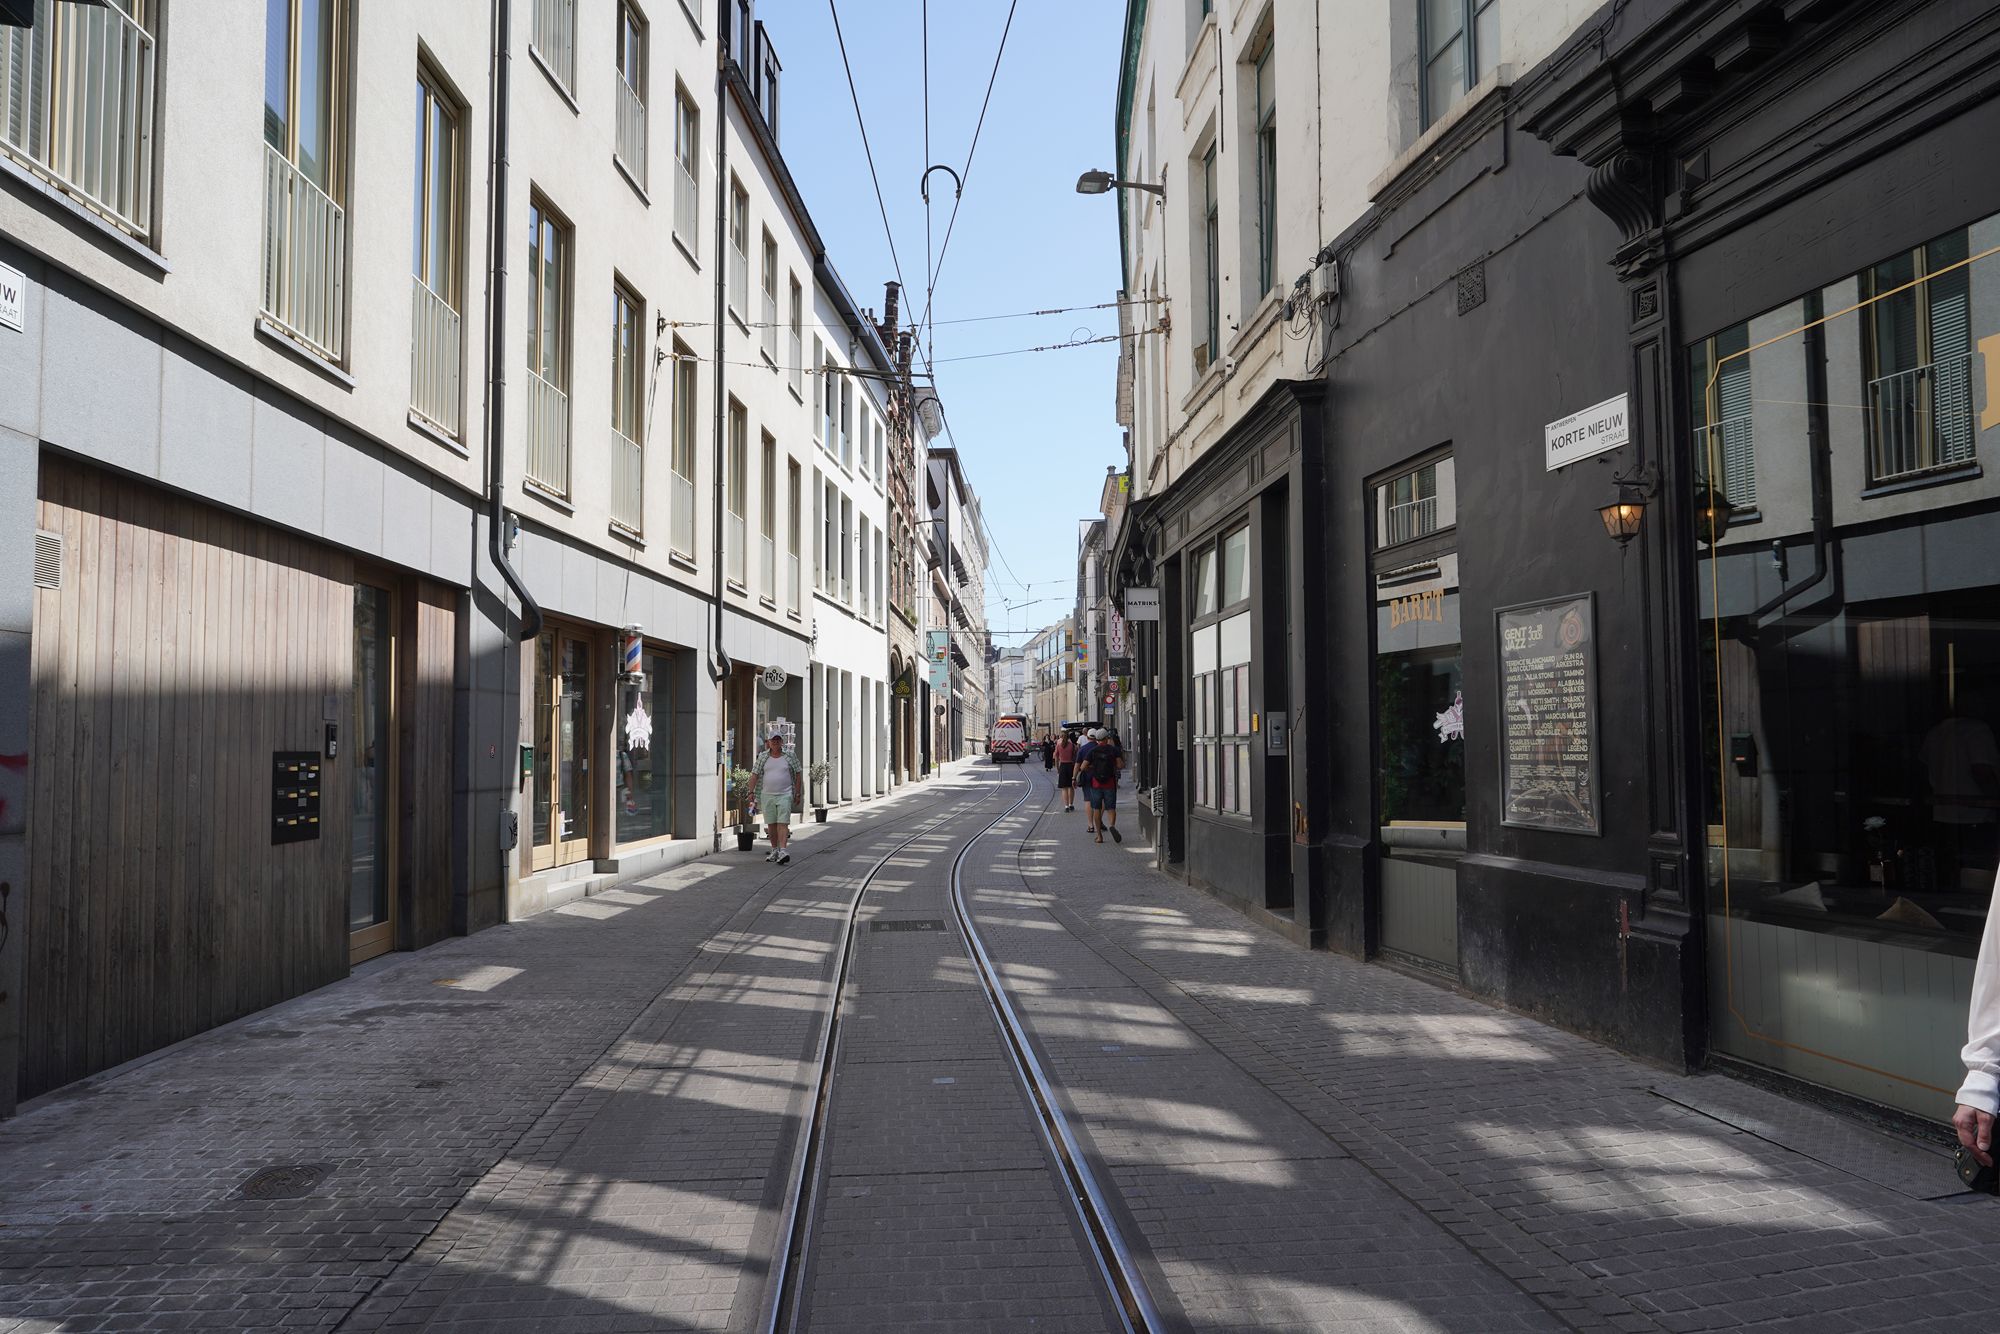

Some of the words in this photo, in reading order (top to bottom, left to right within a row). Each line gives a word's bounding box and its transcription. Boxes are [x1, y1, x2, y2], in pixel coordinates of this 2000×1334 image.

[0, 283, 16, 304] W
[1551, 416, 1577, 431] ANTWERPEN
[1551, 427, 1585, 451] KORTE
[1588, 412, 1623, 437] NIEUW
[1601, 429, 1626, 444] STRAAT
[1390, 587, 1444, 630] BARET
[1504, 626, 1527, 640] GENT
[1505, 638, 1526, 651] JAZZ
[1556, 660, 1584, 668] ARKESTRA
[1528, 688, 1553, 696] MORRISON
